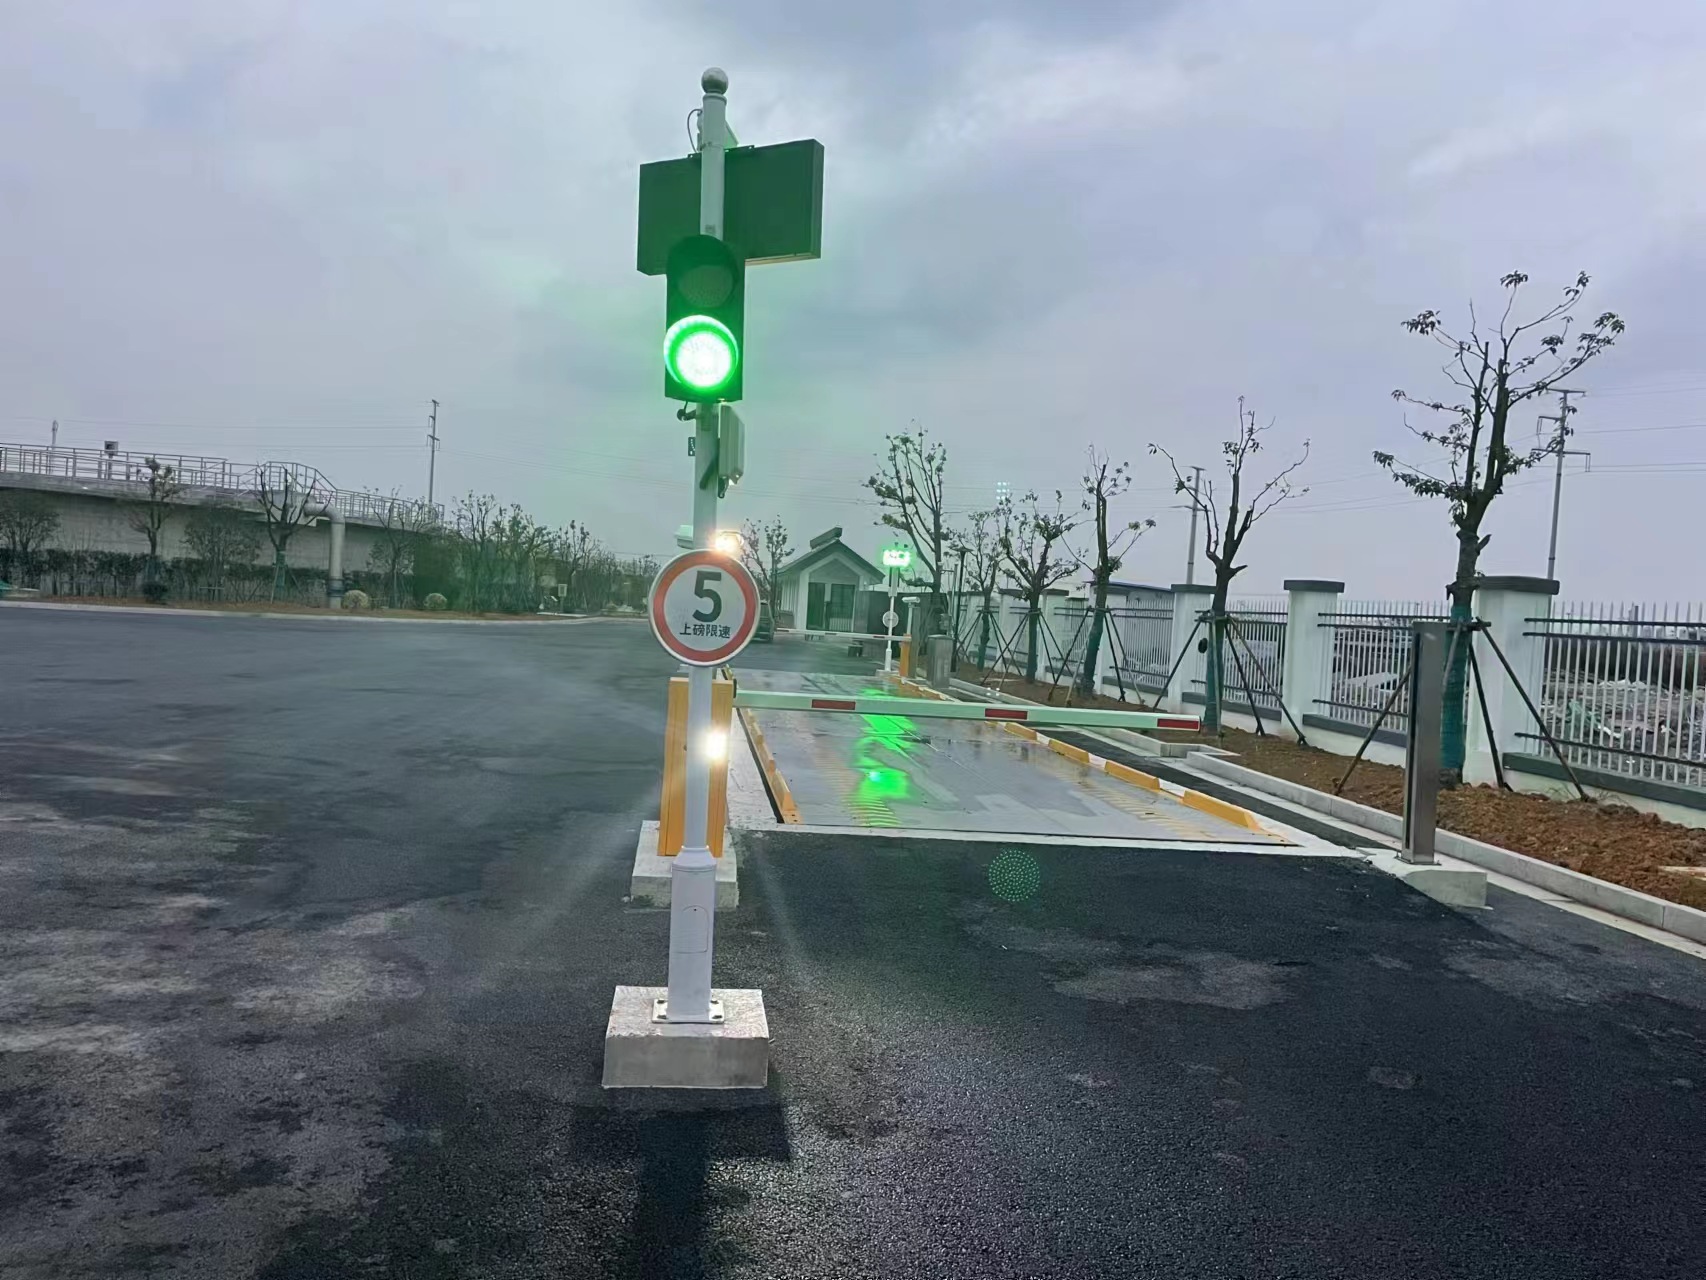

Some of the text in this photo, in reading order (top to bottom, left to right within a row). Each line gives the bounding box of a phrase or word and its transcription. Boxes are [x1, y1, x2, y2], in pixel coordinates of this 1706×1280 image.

[692, 570, 722, 623] 5
[679, 622, 731, 639] 上磅限速
